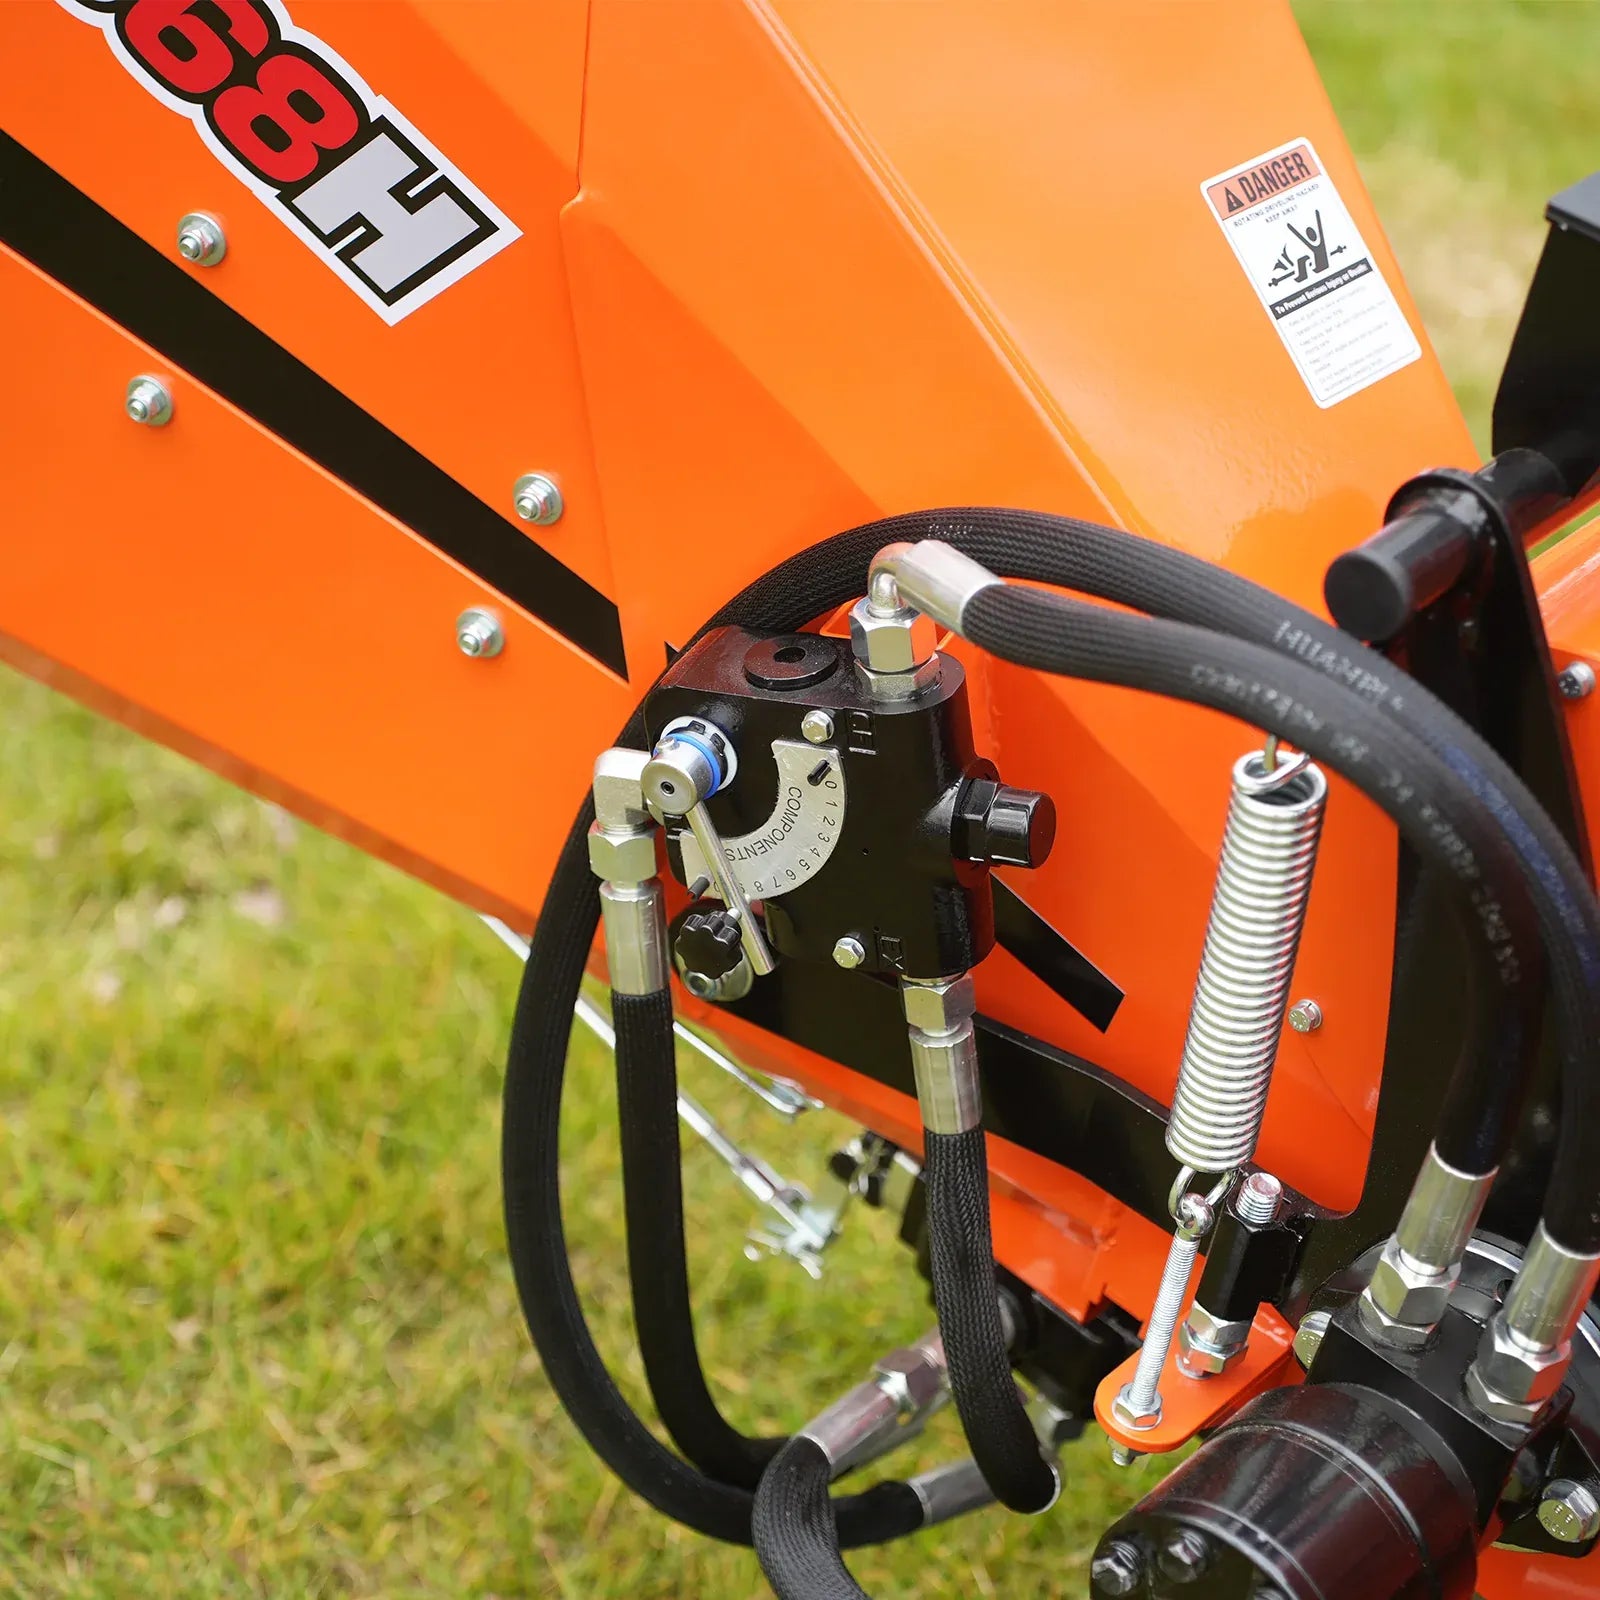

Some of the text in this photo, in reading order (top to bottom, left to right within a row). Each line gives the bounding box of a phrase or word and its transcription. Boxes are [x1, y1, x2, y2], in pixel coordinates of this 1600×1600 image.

[1238, 152, 1311, 203] DANGER
[1233, 209, 1264, 227] ROTATING
[824, 780, 837, 789] 0
[724, 786, 802, 861] COMPONENTS
[822, 815, 836, 827] 2
[817, 832, 830, 843] 3
[809, 847, 821, 858] 4
[798, 859, 811, 871] 5
[785, 868, 797, 880] 6
[753, 880, 764, 892] 8
[772, 875, 781, 888] 7
